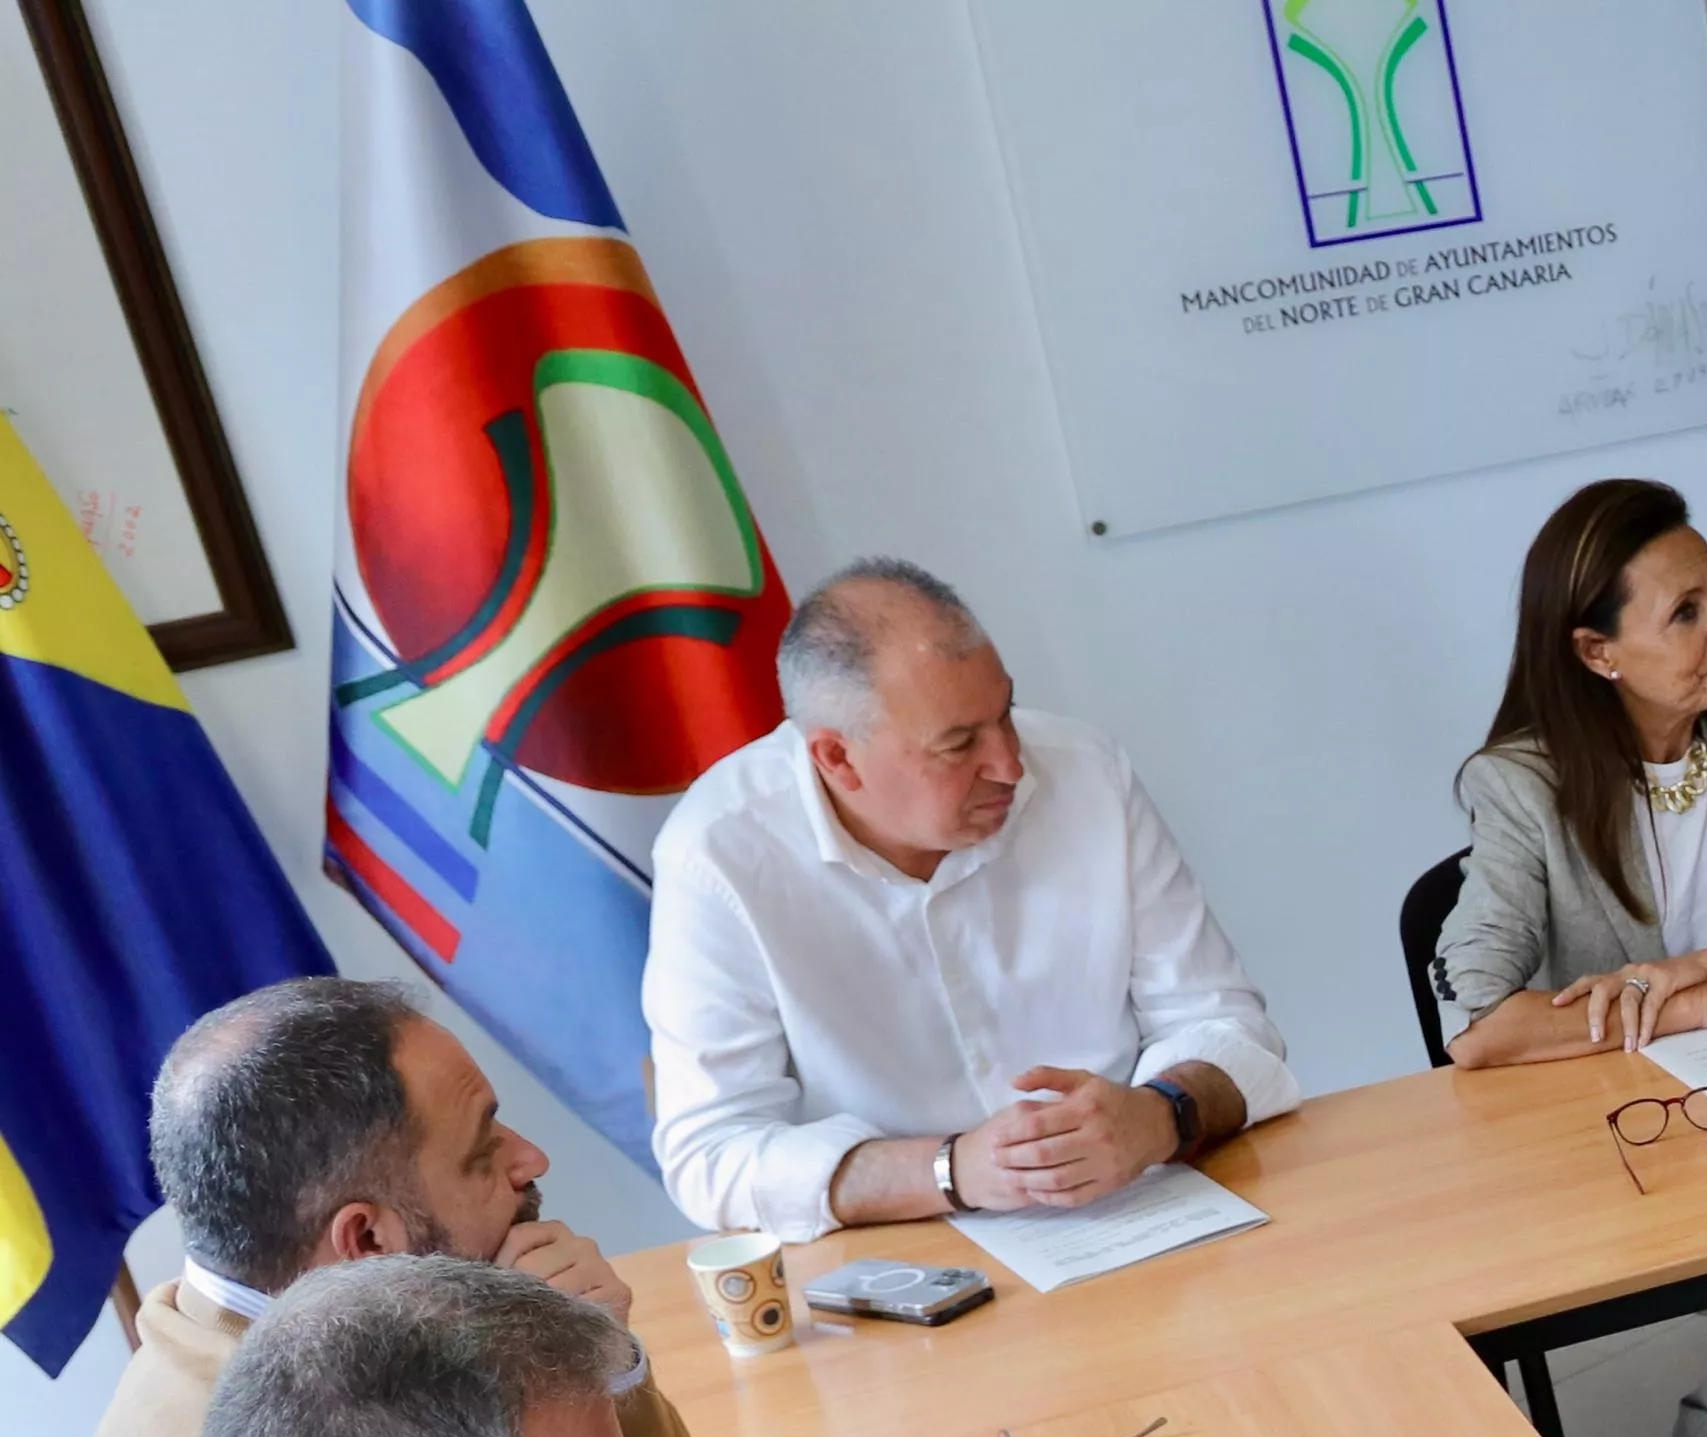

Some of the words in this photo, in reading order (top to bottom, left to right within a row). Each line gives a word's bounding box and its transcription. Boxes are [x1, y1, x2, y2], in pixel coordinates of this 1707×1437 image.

[1180, 260, 1391, 314] MANCOMUNIDAD
[1396, 258, 1420, 279] DE
[1424, 223, 1619, 274] AYUNTAMIENTOS
[1242, 313, 1275, 335] DEL
[1279, 295, 1360, 328] NORTE
[1366, 294, 1390, 314] DE
[1393, 278, 1461, 308] GRAN
[1467, 262, 1573, 296] CANARIA
